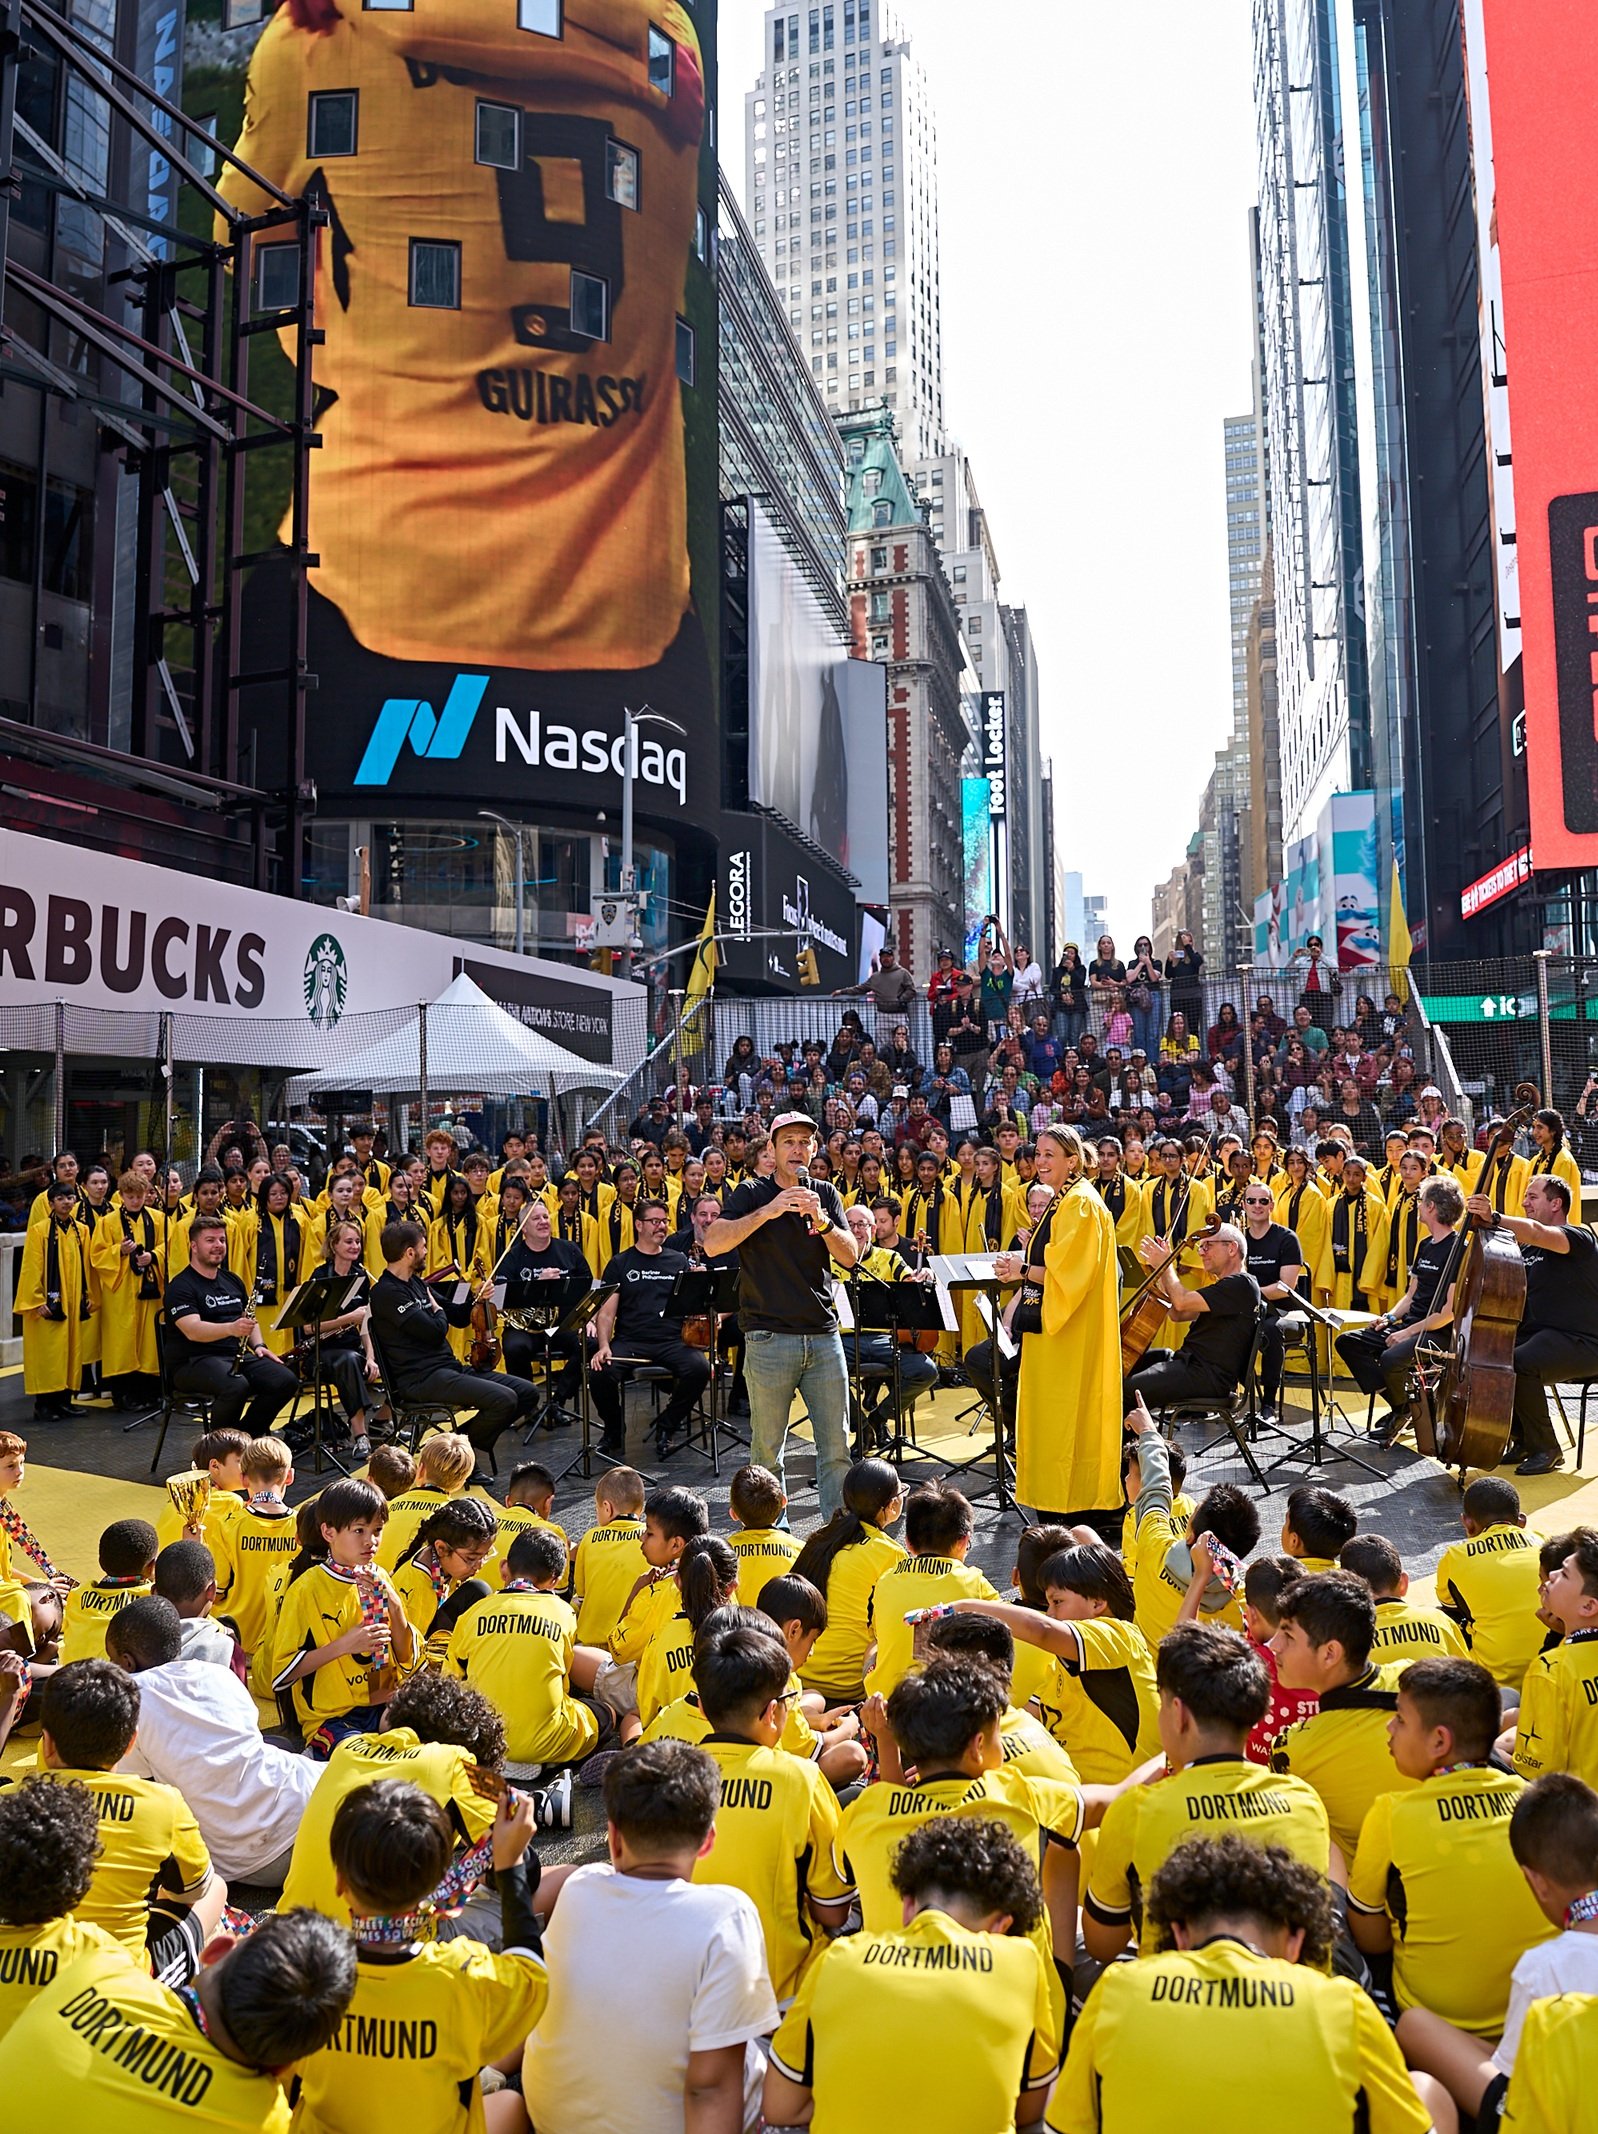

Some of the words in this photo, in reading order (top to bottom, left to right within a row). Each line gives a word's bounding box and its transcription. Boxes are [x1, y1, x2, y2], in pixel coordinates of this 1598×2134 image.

[496, 110, 625, 354] 9
[495, 706, 687, 806] Nasdaq
[0, 884, 266, 1009] RBUCKS
[242, 1535, 298, 1552] DORTMUND
[894, 1557, 953, 1576] DORTMUND
[477, 1614, 561, 1643] DORTMUND
[1186, 1792, 1291, 1821] DORTMUND
[0, 1947, 59, 1986] UND
[863, 1943, 994, 1973] DORTMUND
[1151, 1974, 1295, 2008] DORTMUND
[58, 1986, 214, 2107] DORTMUND
